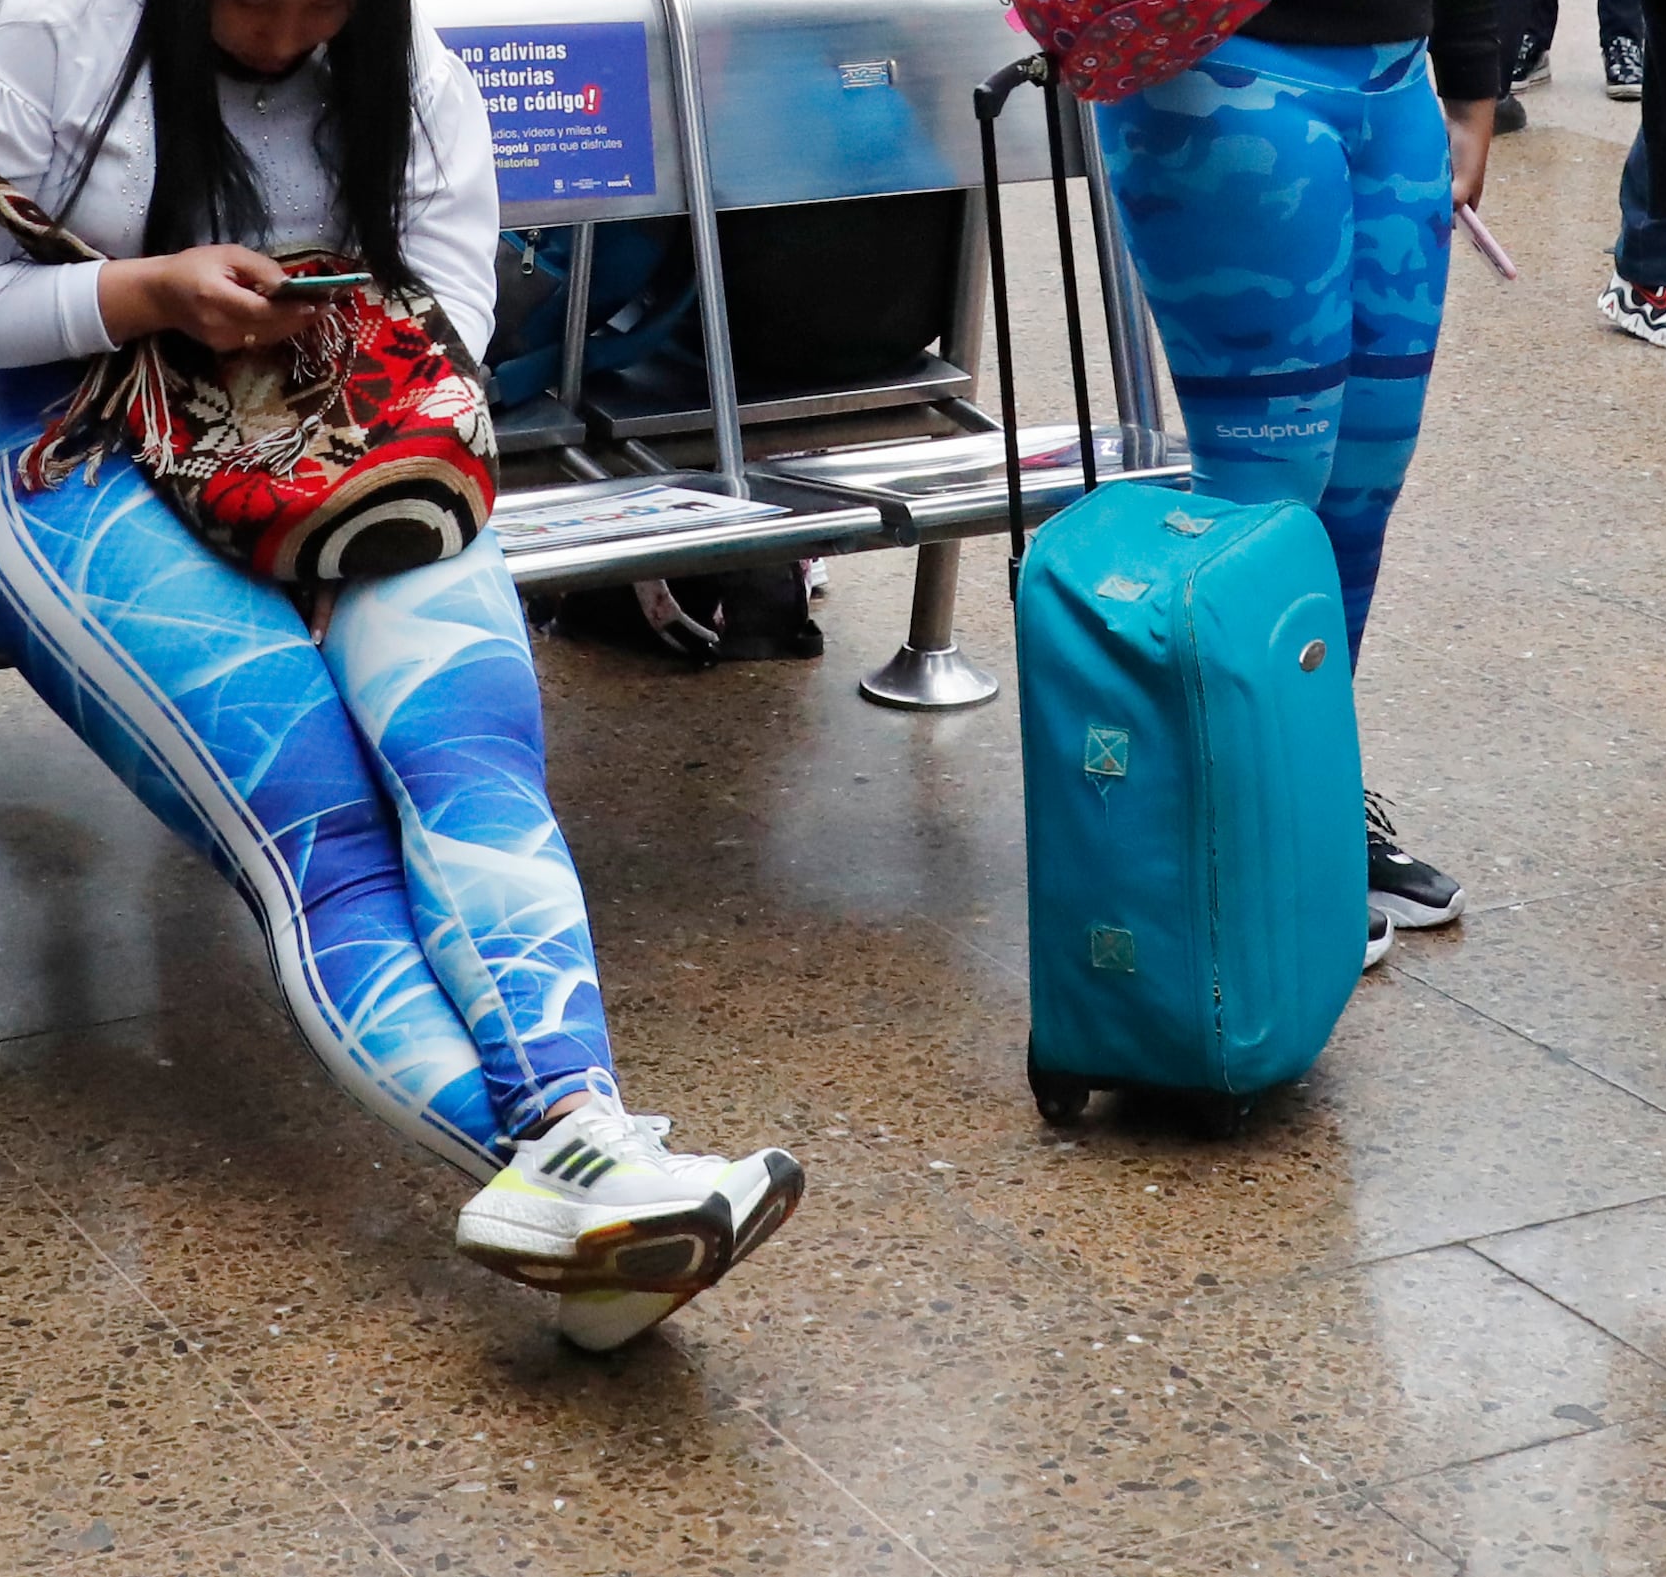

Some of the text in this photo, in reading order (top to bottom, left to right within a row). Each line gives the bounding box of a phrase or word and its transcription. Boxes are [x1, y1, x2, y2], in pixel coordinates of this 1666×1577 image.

[461, 41, 567, 62] no adivinas
[473, 66, 555, 88] historias
[482, 88, 596, 114] este código!
[557, 128, 564, 139] y
[565, 125, 592, 137] miles
[593, 124, 608, 136] de
[492, 138, 623, 157] Bogotá para que disfrutes
[493, 157, 540, 170] Historias
[1216, 418, 1330, 442] Sculpture
